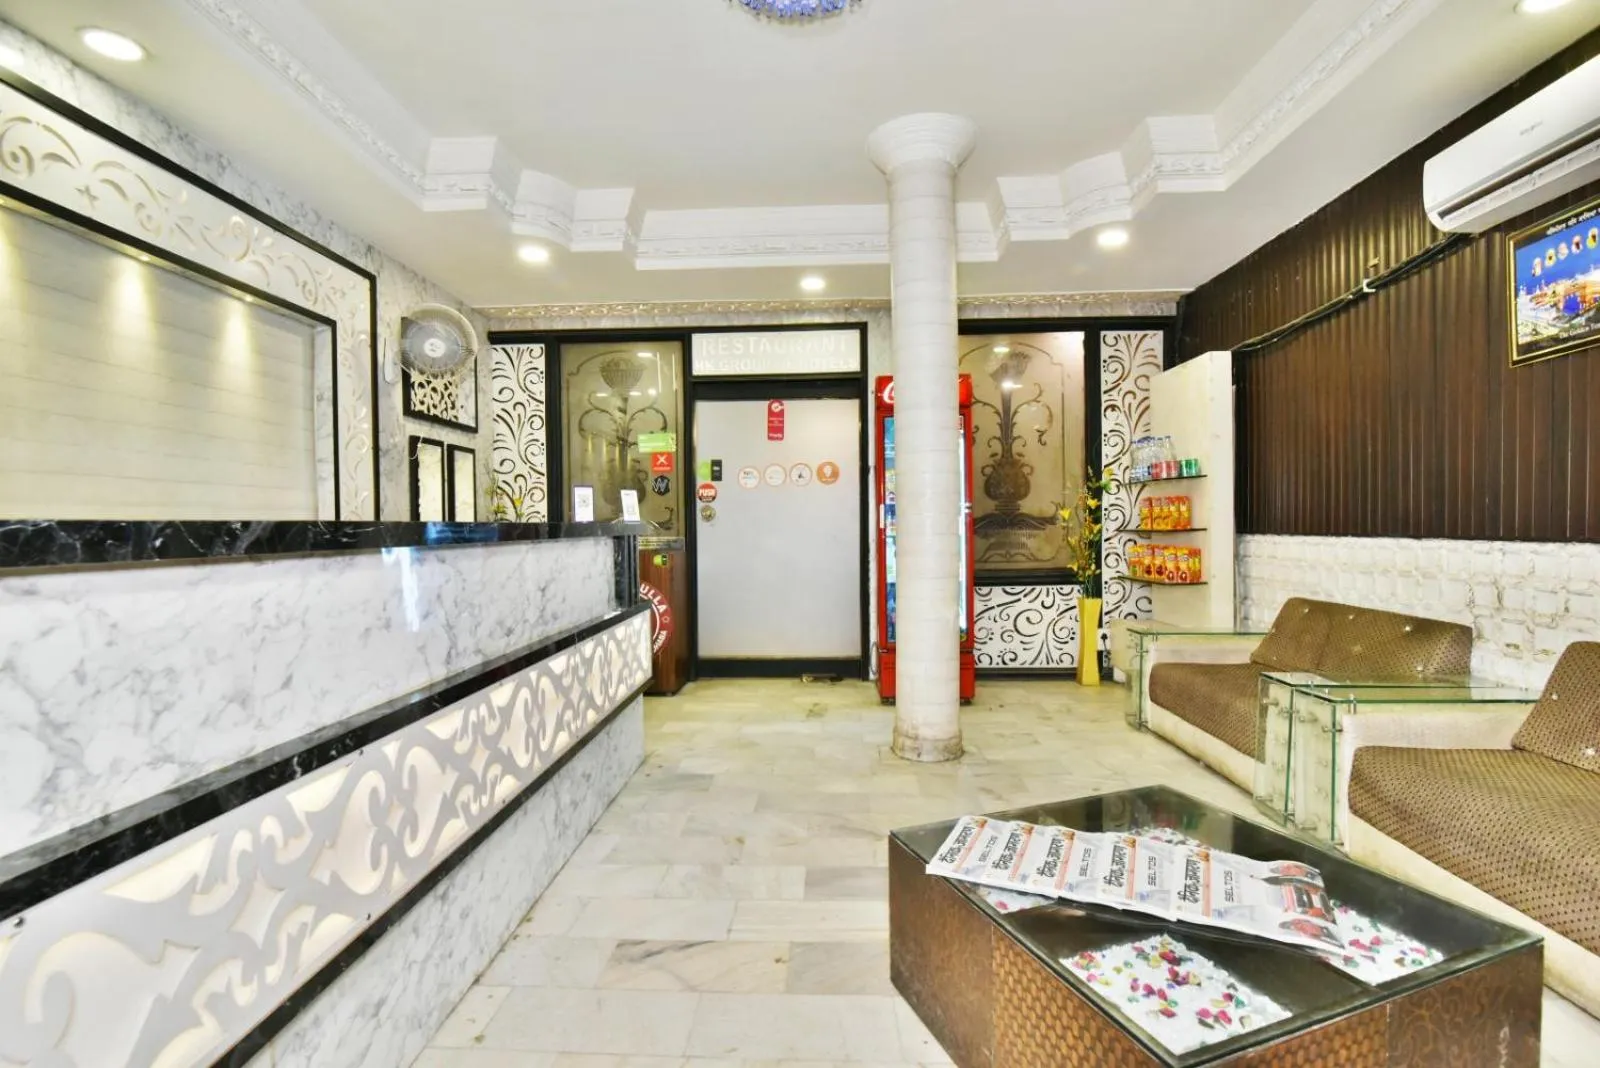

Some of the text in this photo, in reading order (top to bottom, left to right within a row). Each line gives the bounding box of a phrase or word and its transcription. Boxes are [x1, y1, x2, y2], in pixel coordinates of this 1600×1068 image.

[701, 336, 847, 357] RESTAURANT
[1147, 855, 1158, 887] SELTOS
[1223, 869, 1235, 903] SELTOS
